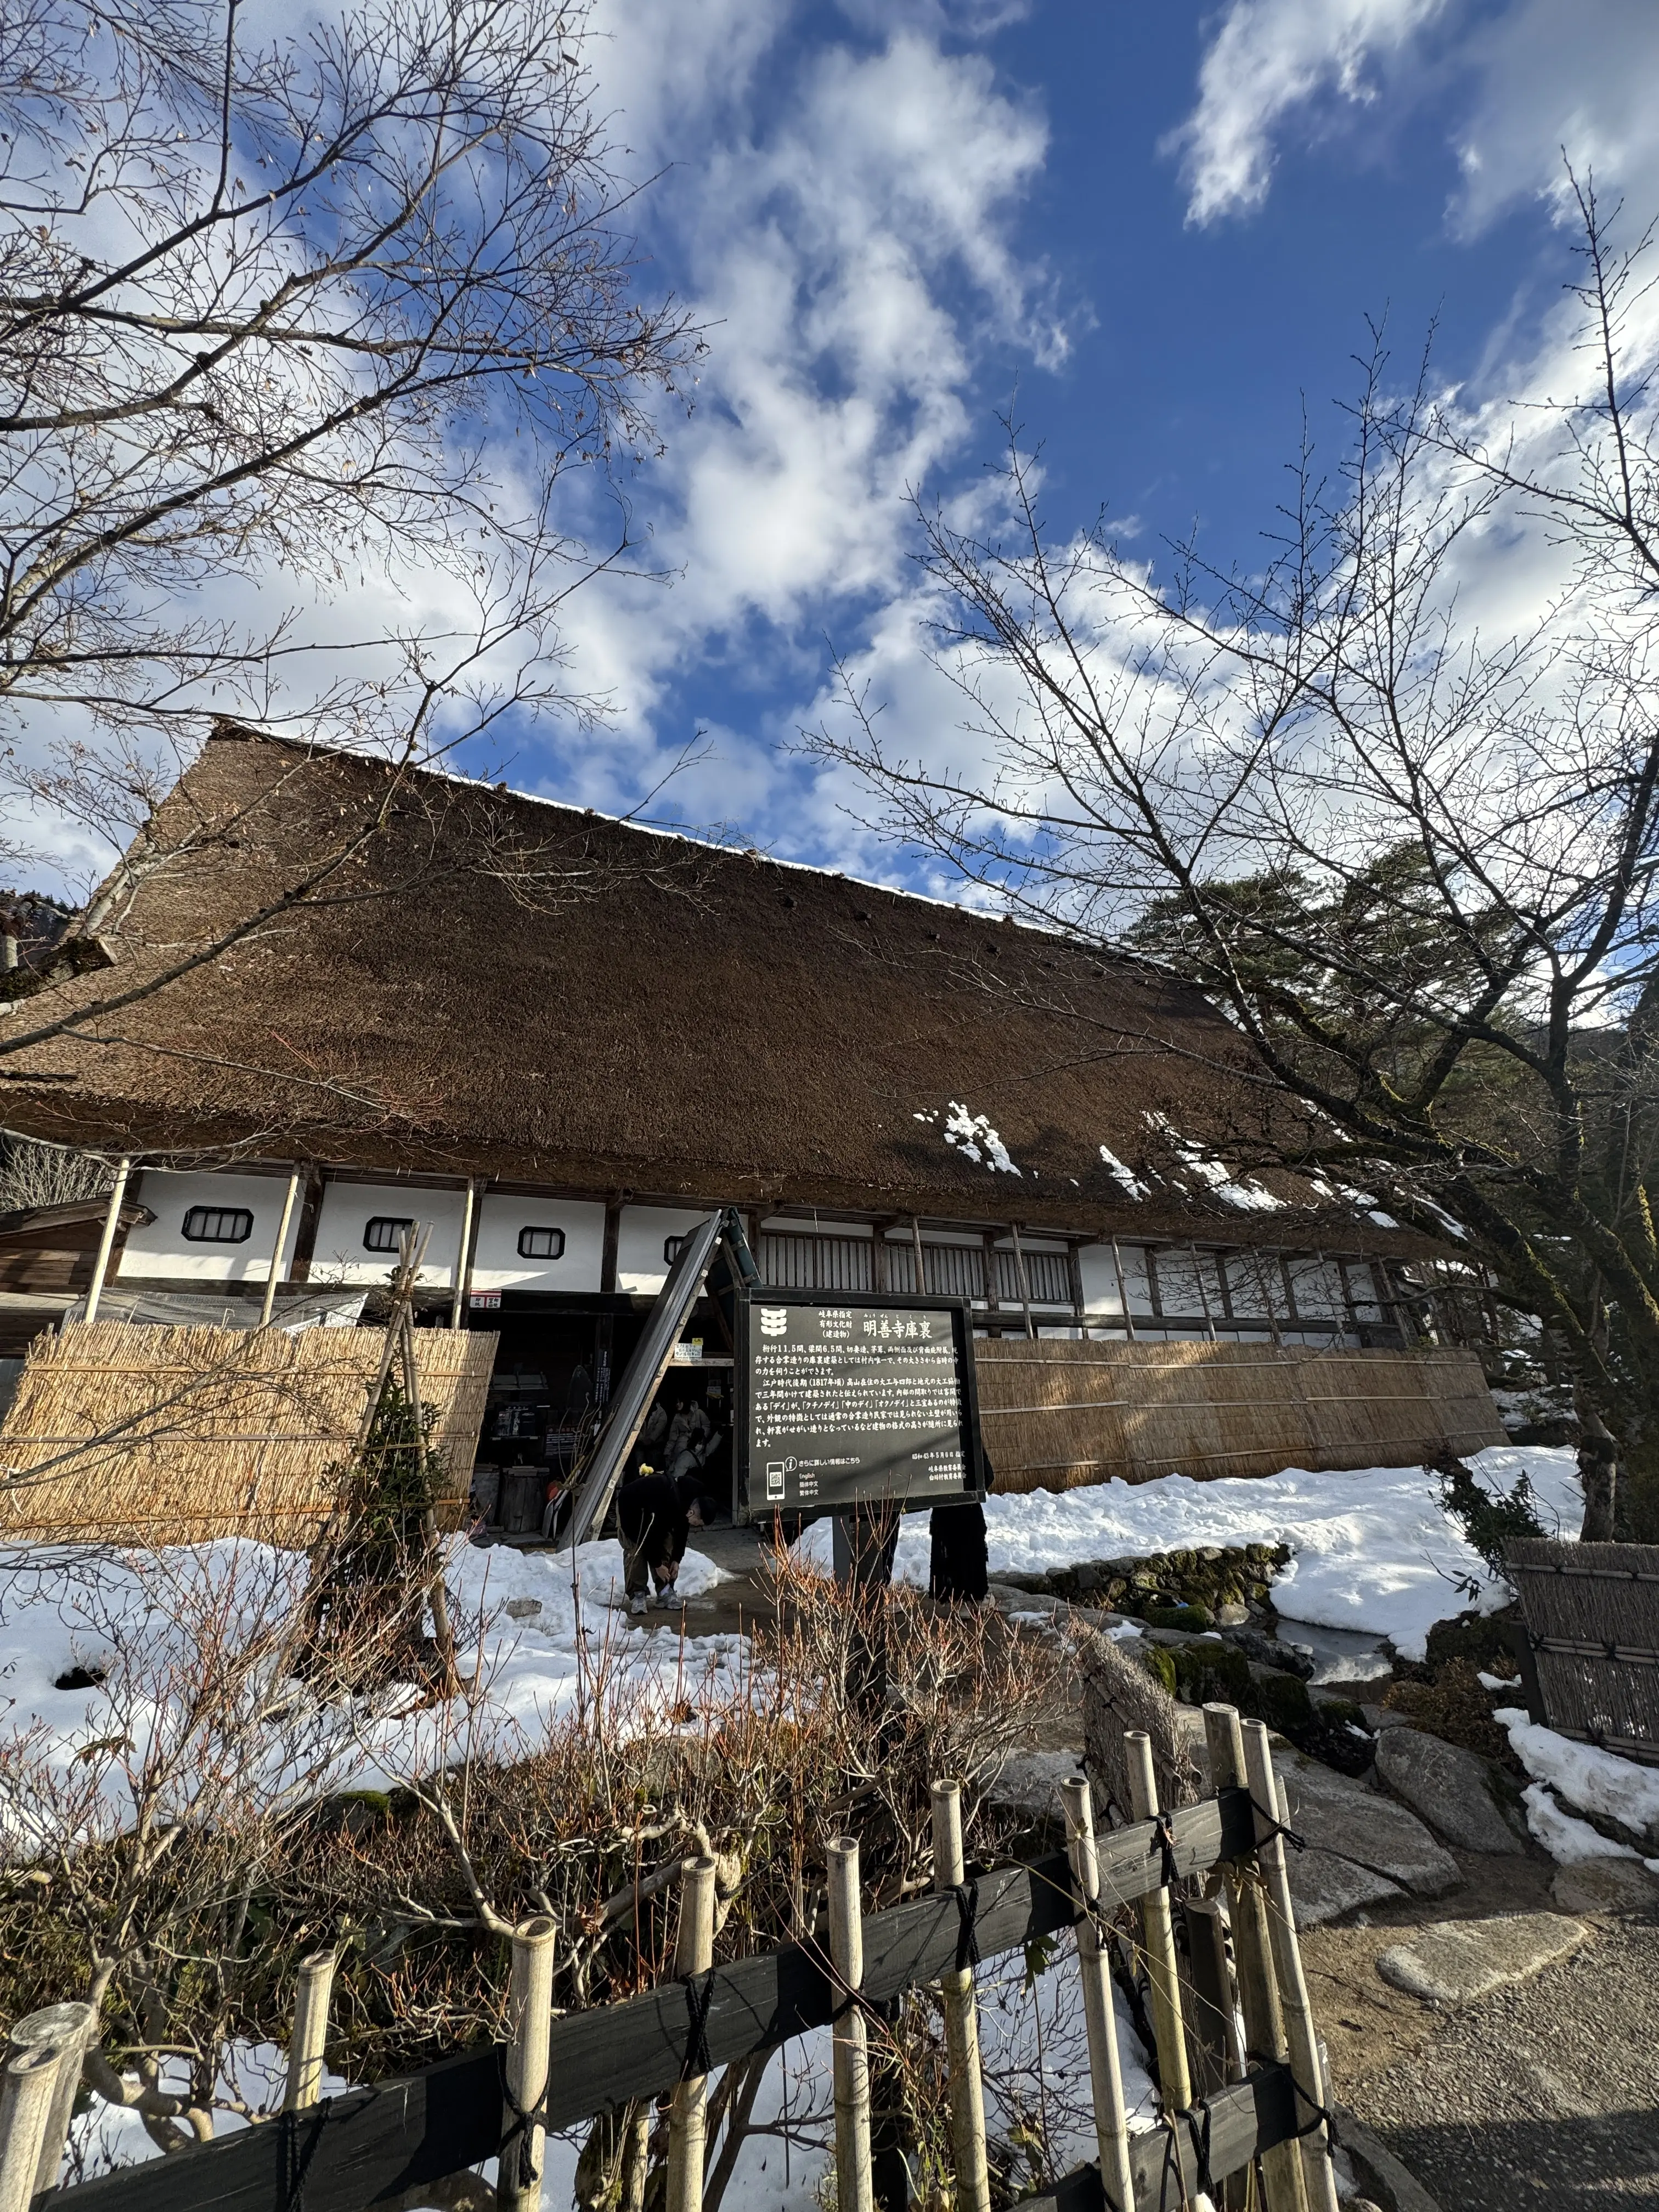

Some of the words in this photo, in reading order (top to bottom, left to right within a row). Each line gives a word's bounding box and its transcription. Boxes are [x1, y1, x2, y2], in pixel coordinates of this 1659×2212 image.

[819, 1310, 853, 1318] 岐阜県指定
[820, 1320, 853, 1328] 有形文化財
[863, 1319, 933, 1339] 明善寺庫裏
[755, 1367, 834, 1376] の力を伺うことができます。
[755, 1438, 771, 1448] ます。
[798, 1457, 860, 1468] さらに詳しい情報はこちら
